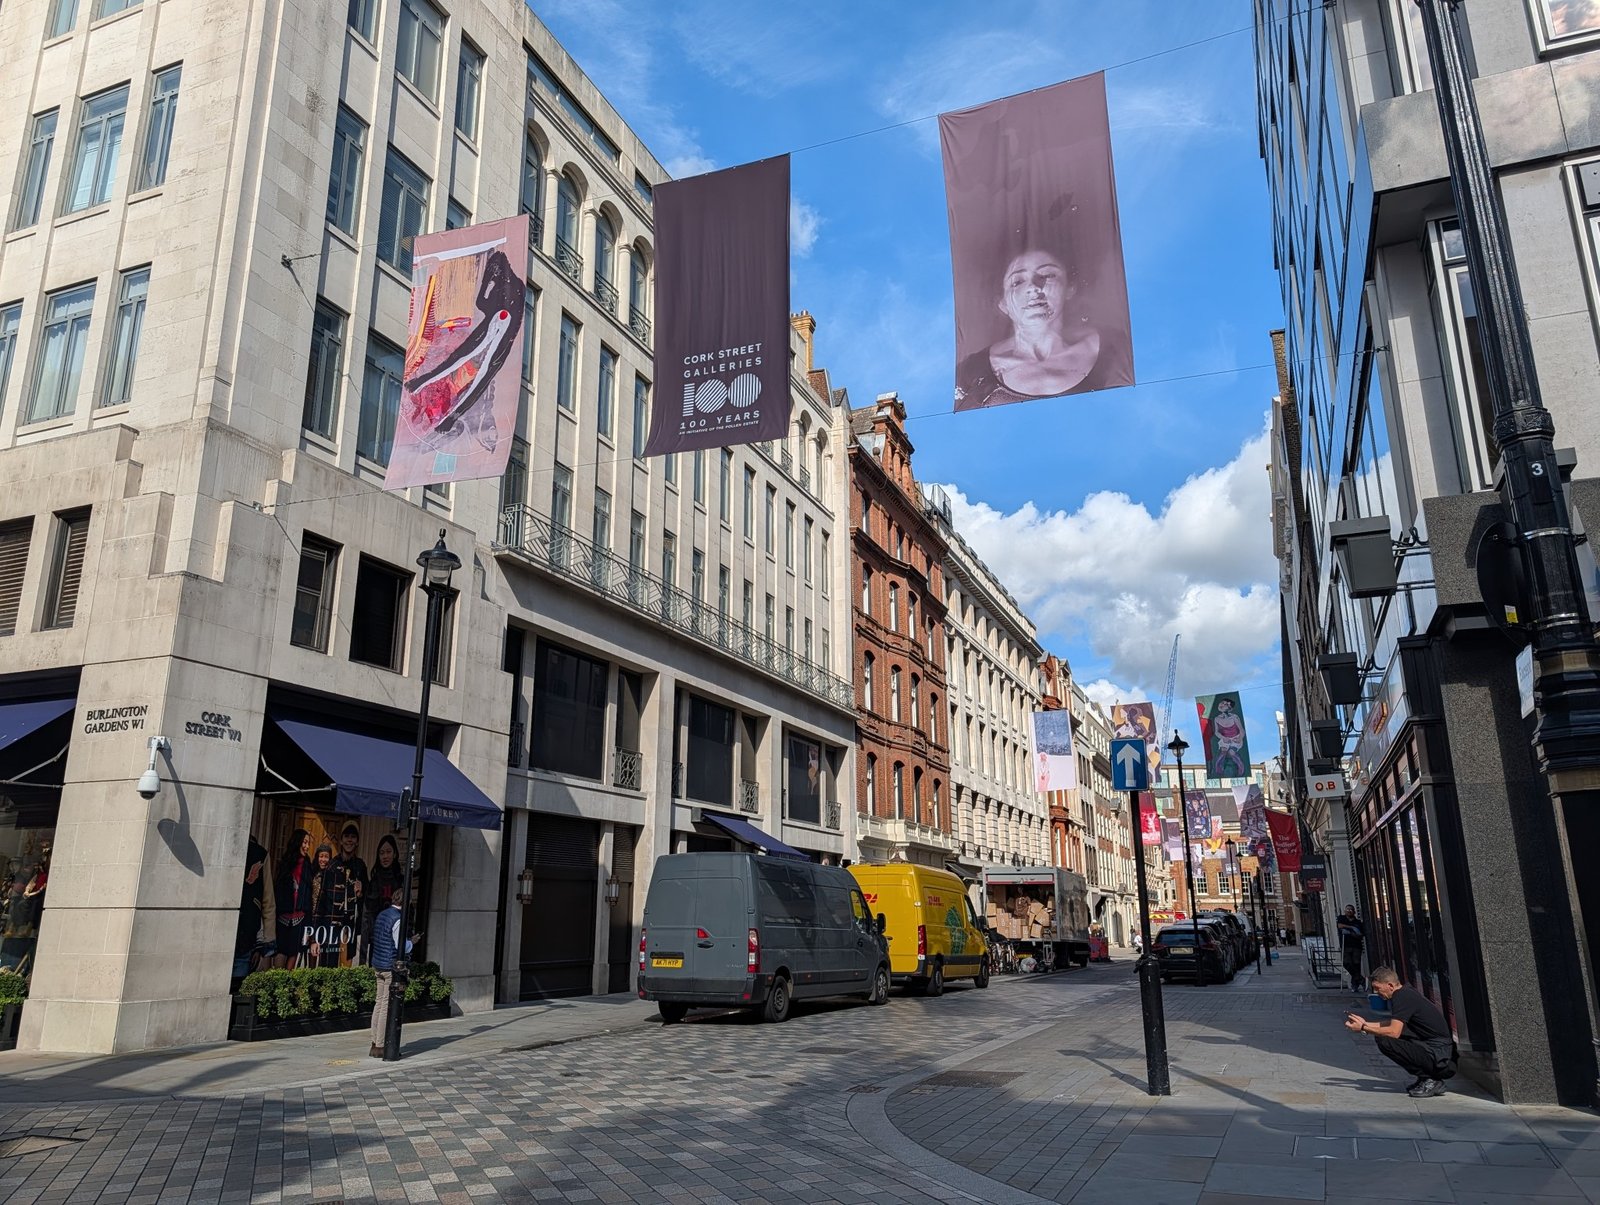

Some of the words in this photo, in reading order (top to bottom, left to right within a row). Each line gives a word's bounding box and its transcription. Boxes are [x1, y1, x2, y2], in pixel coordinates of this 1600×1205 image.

[684, 352, 714, 365] CORK
[718, 343, 762, 359] STREET
[683, 357, 762, 378] GALLERIES
[680, 419, 706, 430] 100
[716, 410, 760, 424] YEARS
[1531, 462, 1543, 475] 3
[86, 705, 149, 721] BURLINGTON
[201, 711, 232, 728] CORK
[84, 720, 129, 734] GARDENS
[184, 721, 227, 738] STREET
[425, 807, 460, 819] LAUREN
[302, 925, 352, 946] POLO
